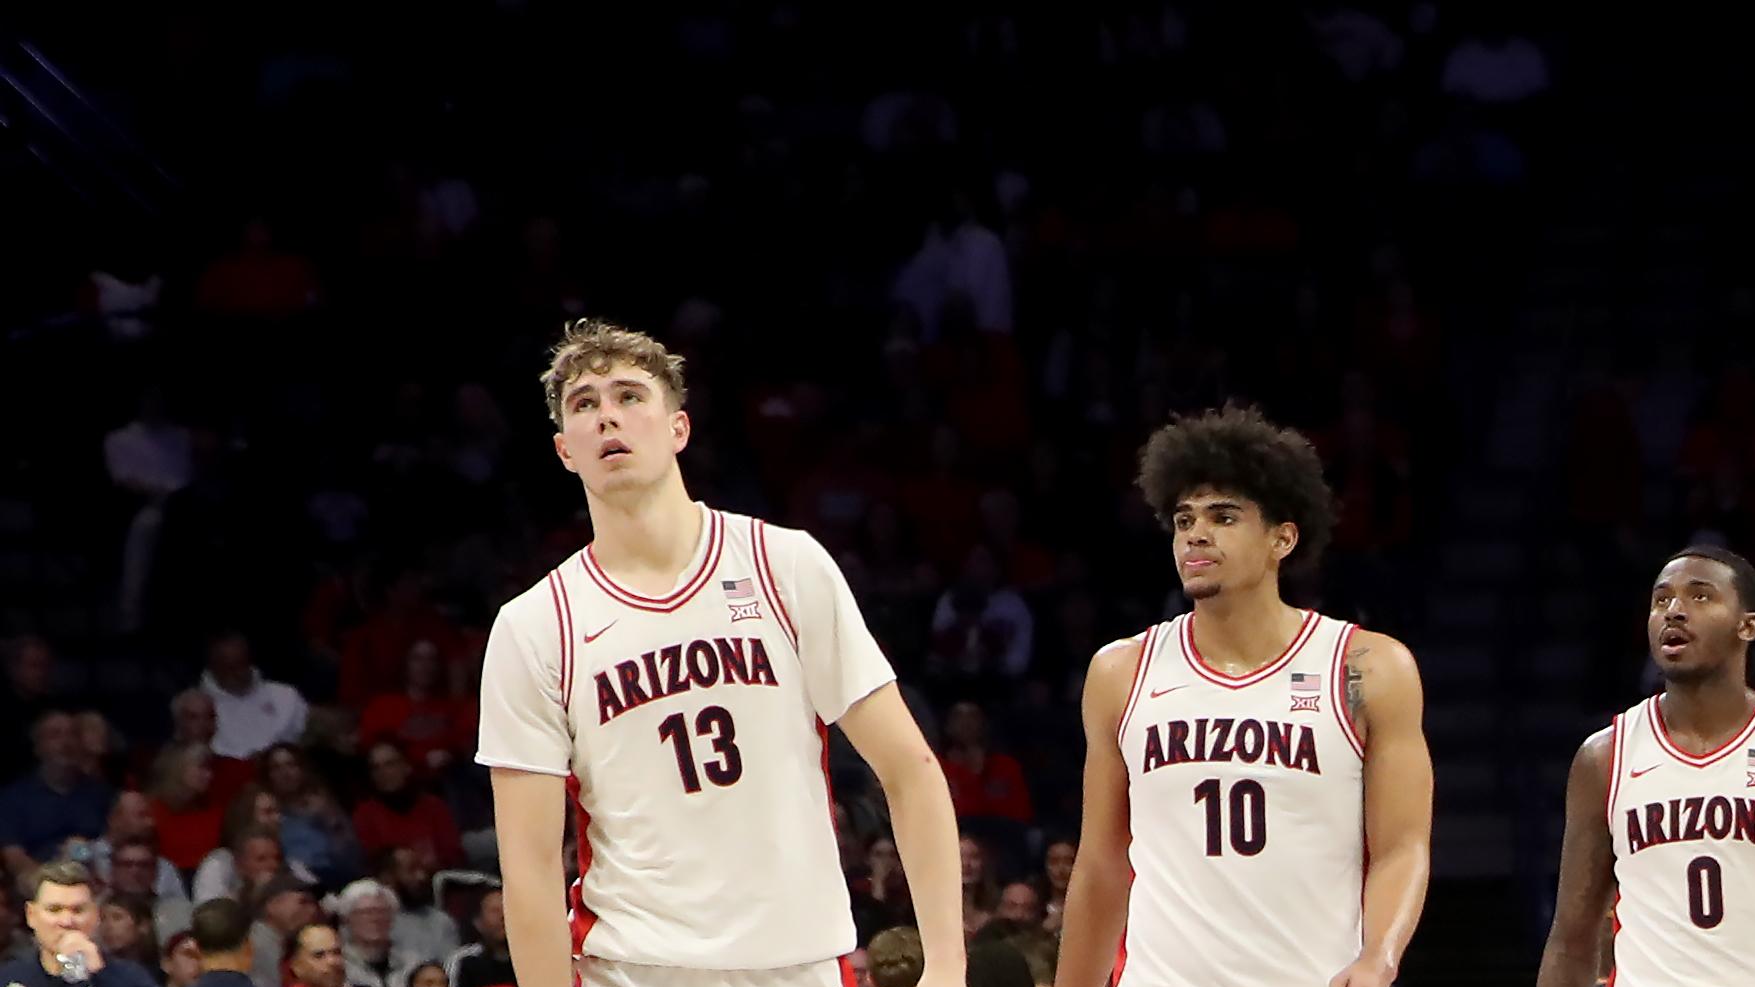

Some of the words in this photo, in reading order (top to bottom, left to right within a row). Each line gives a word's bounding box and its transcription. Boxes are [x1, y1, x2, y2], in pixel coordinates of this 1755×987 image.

[593, 637, 779, 726] ARIZONA
[658, 705, 743, 794] 13
[1143, 718, 1321, 775] ARIZONA
[1193, 778, 1266, 857] 10
[1687, 855, 1724, 929] 0
